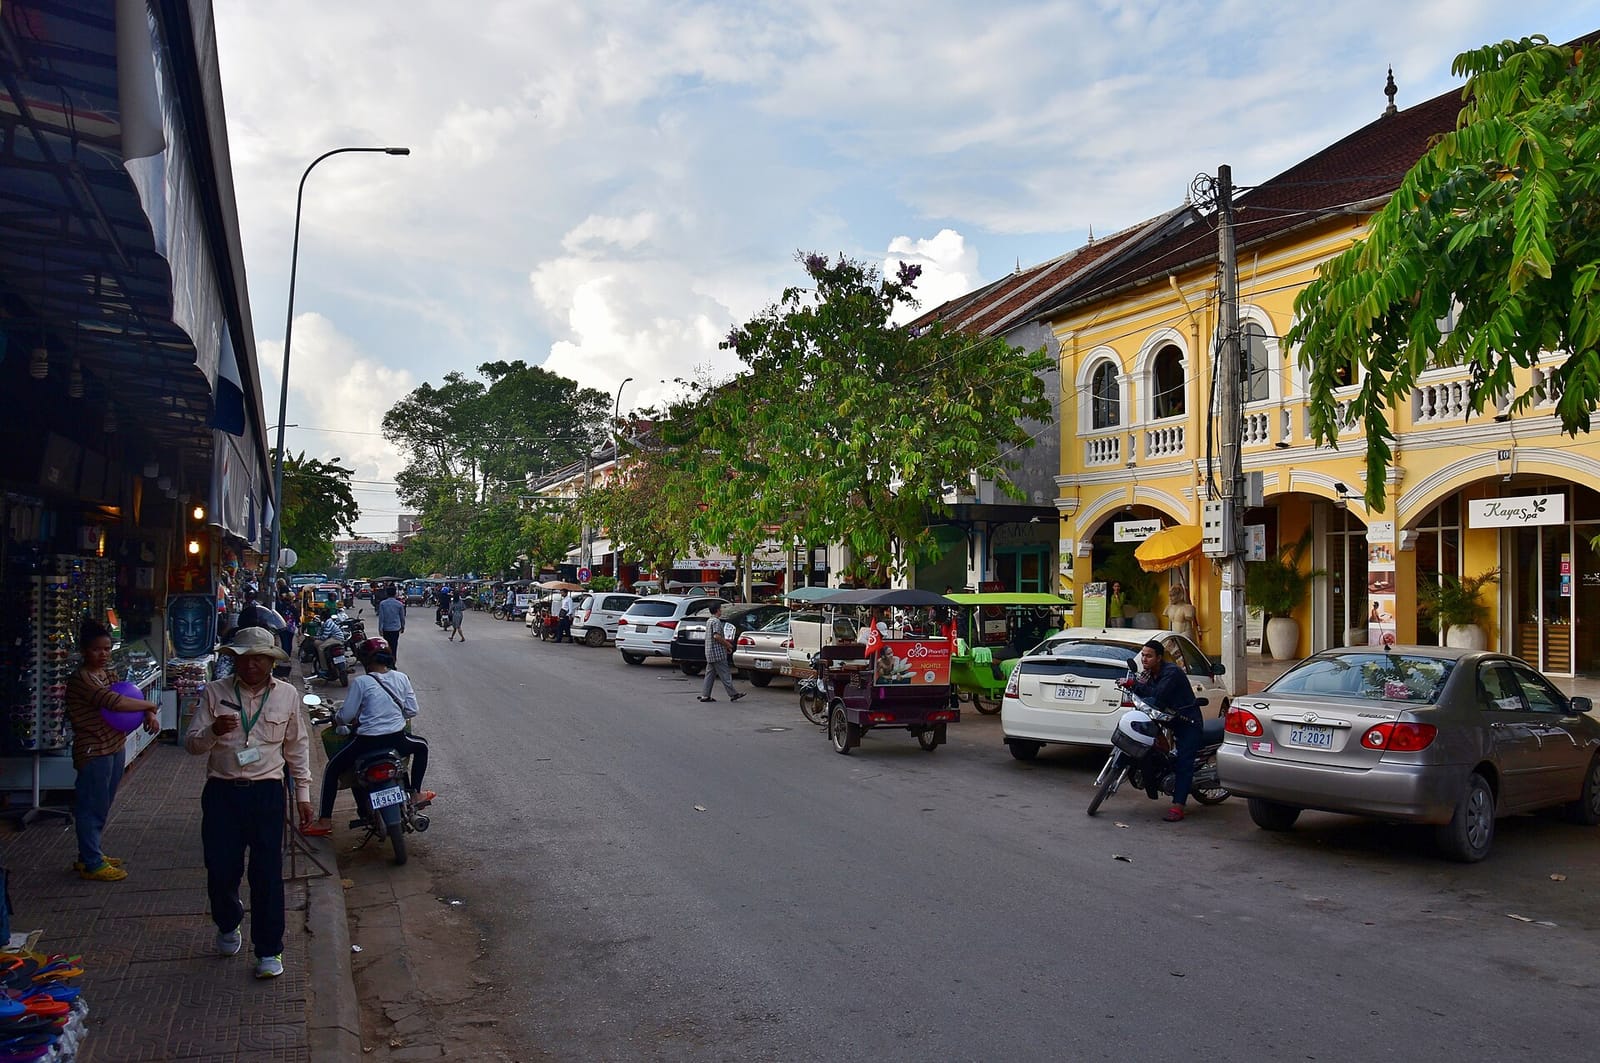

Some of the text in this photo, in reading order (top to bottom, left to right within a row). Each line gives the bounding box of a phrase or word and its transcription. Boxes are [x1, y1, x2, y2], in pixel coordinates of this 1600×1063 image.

[1500, 450, 1509, 459] 10
[1483, 502, 1538, 522] Kaya Spa
